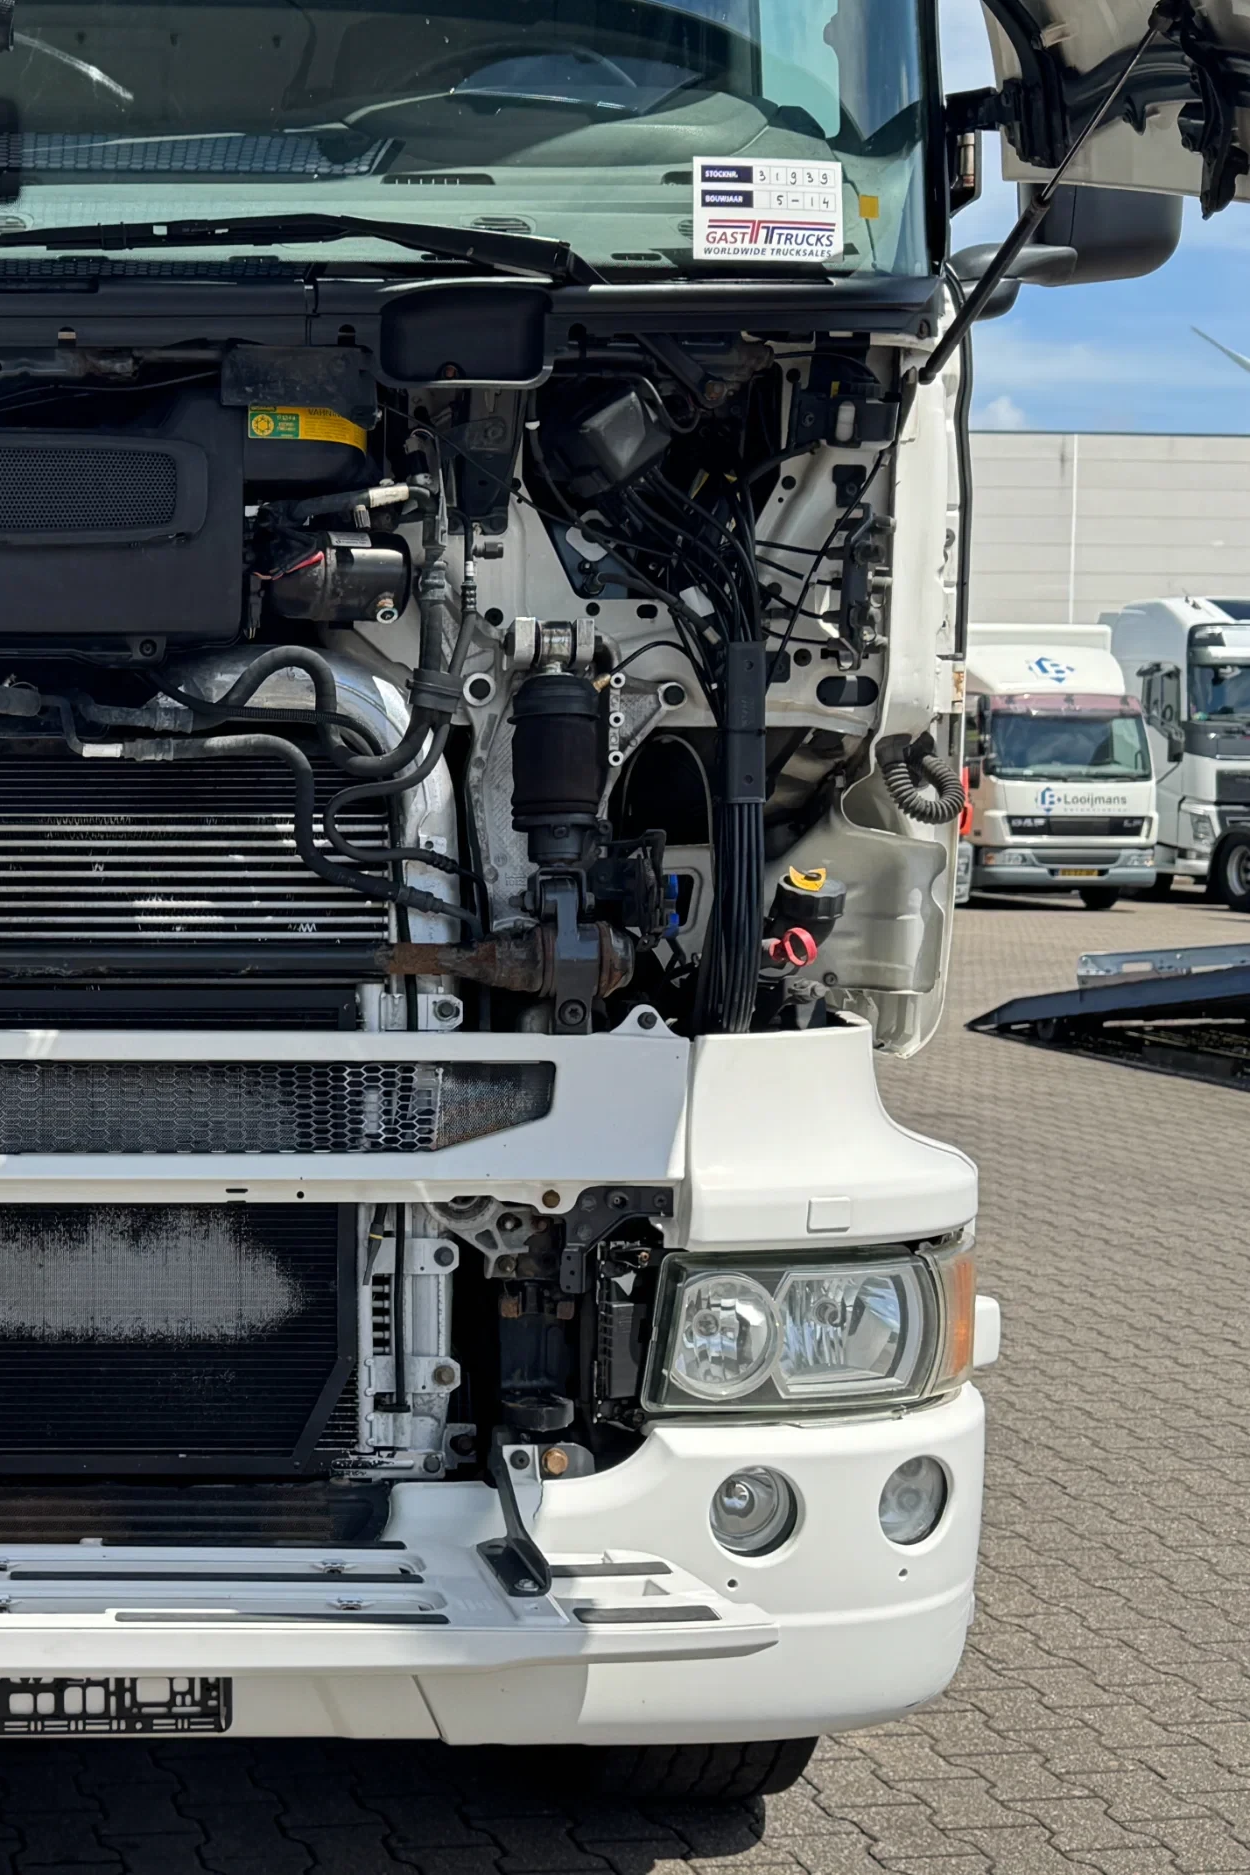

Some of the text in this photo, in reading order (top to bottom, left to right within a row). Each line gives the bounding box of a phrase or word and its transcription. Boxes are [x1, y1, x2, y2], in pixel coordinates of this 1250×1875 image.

[758, 170, 830, 186] 31939
[703, 246, 832, 258] WORLDWIDE TRUCKSALES
[1063, 793, 1128, 808] Looijmans
